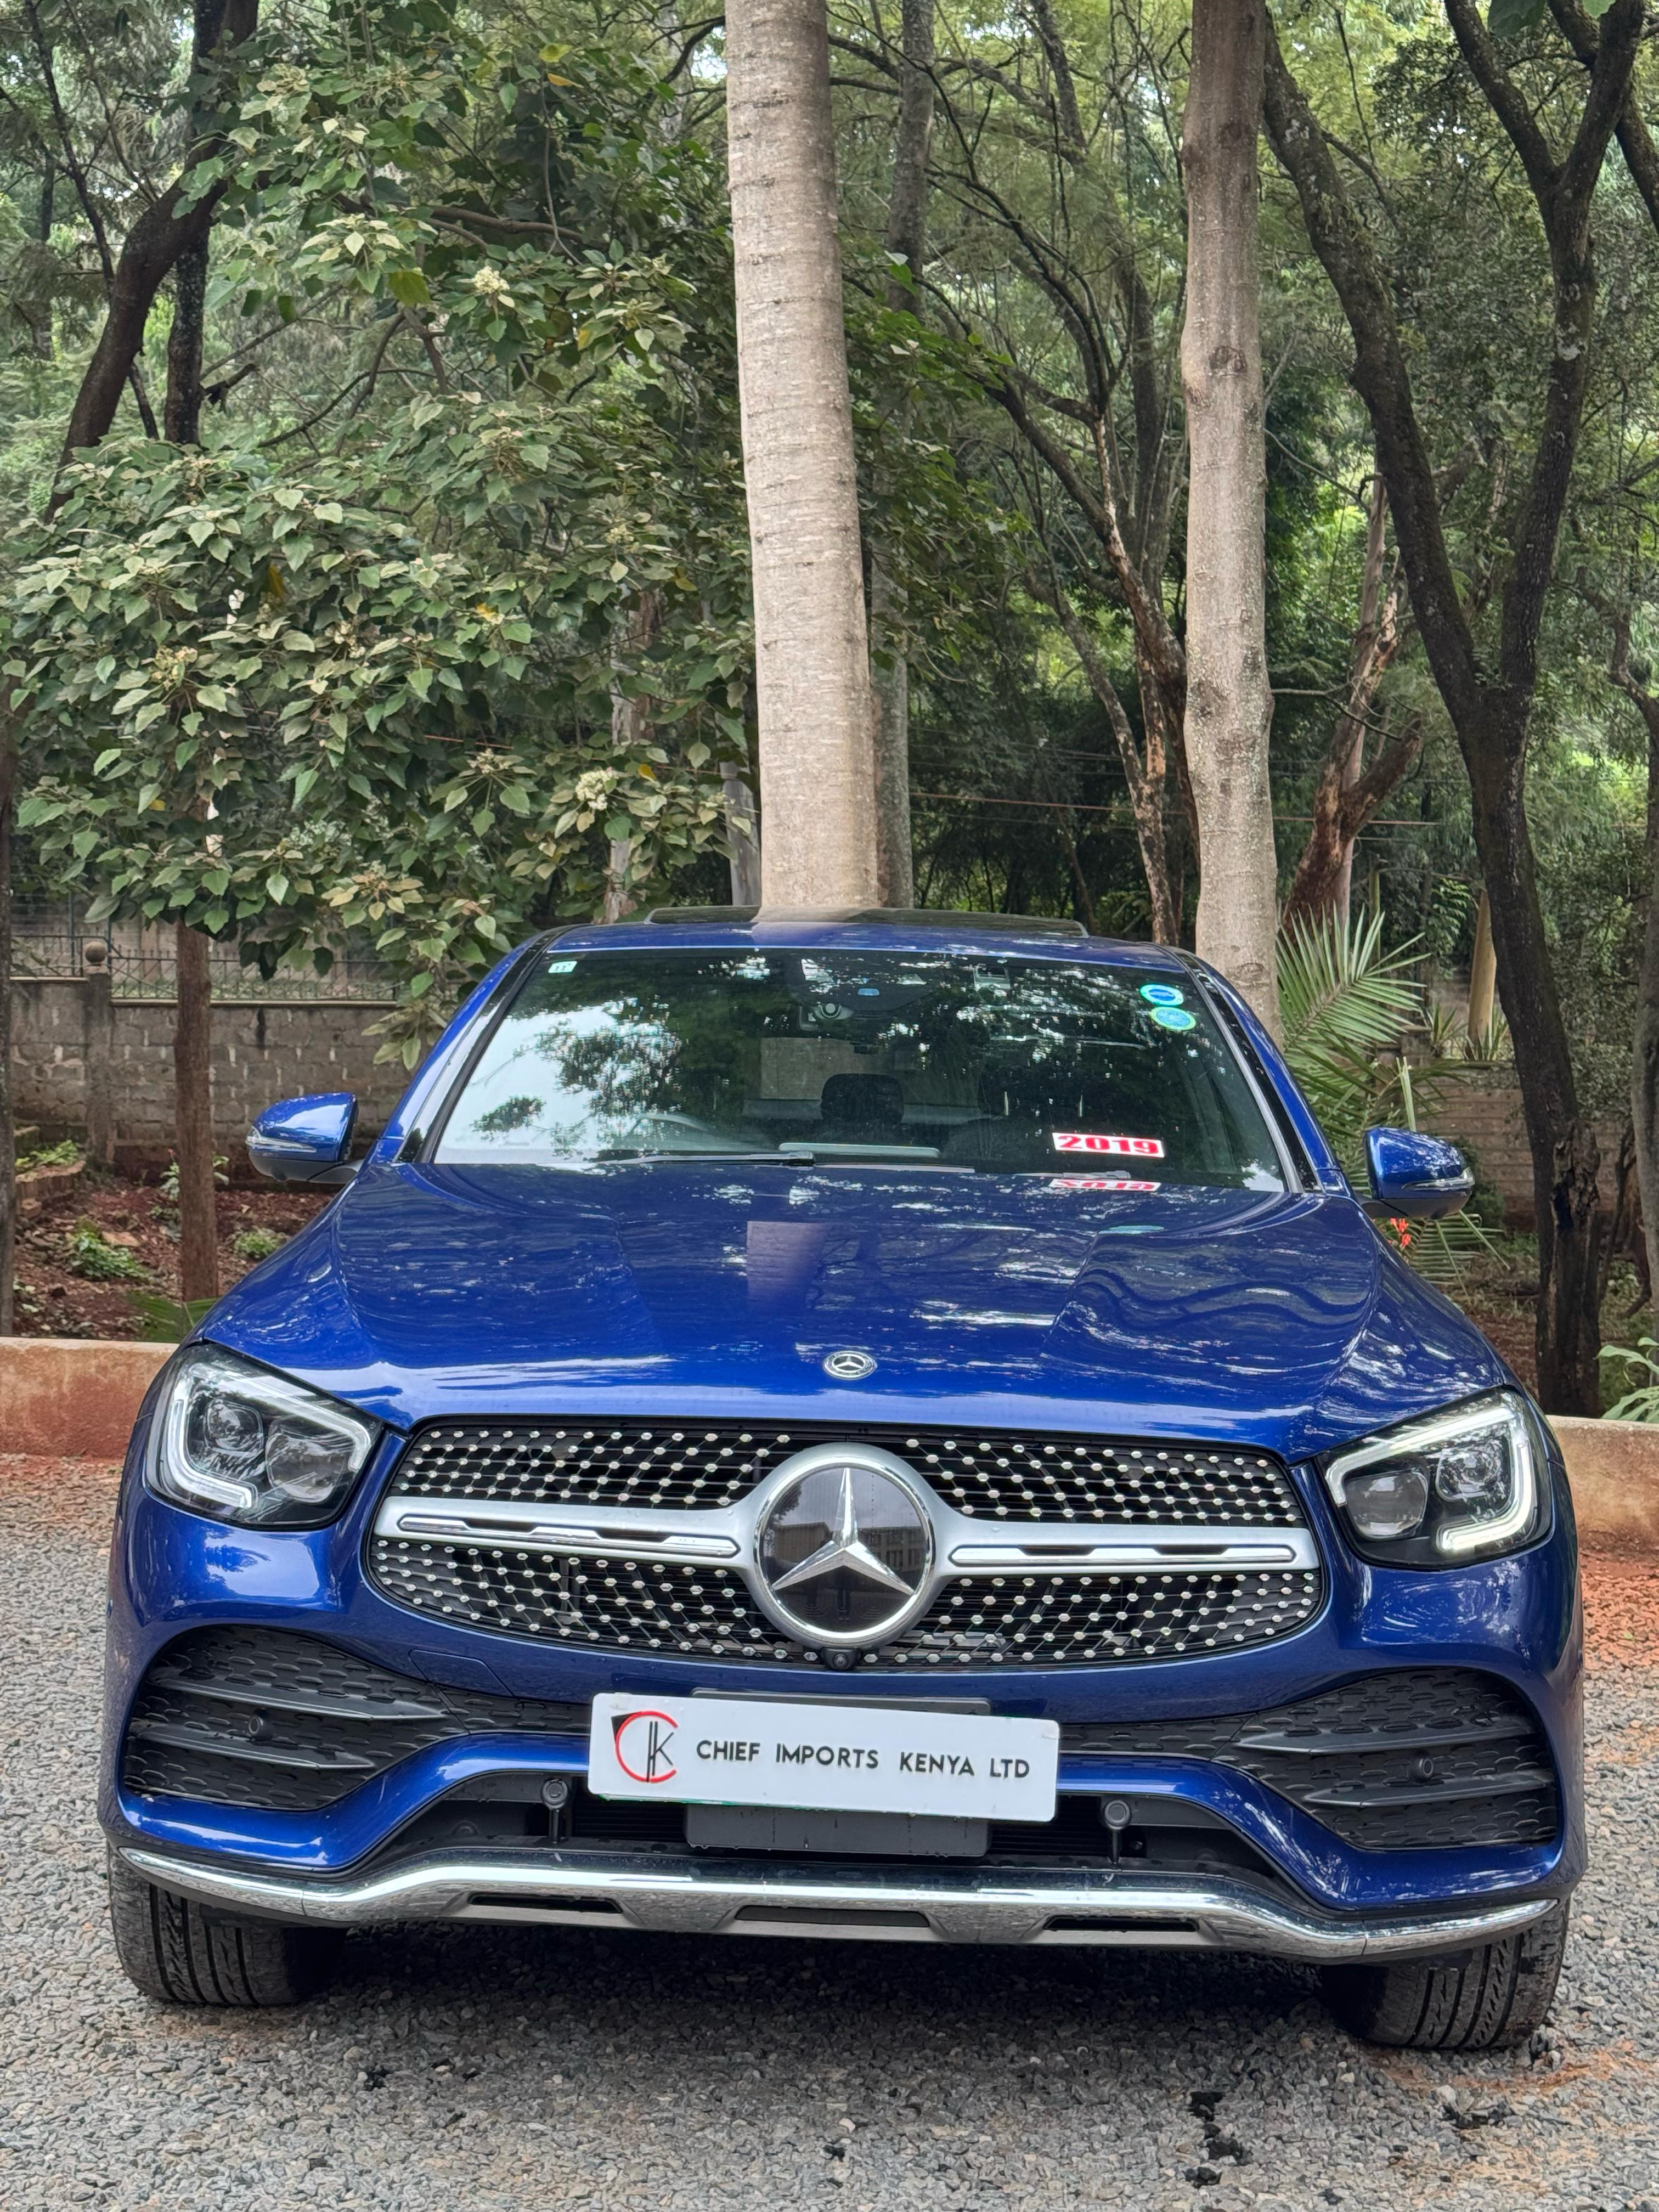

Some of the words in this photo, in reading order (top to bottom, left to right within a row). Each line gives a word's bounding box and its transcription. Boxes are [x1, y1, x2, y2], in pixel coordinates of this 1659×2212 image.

[1058, 1135, 1159, 1154] 2019
[696, 1740, 760, 1762] CHIEF
[776, 1743, 879, 1769] IMPORTS
[899, 1752, 975, 1776] KENYA
[990, 1758, 1030, 1778] LTD
